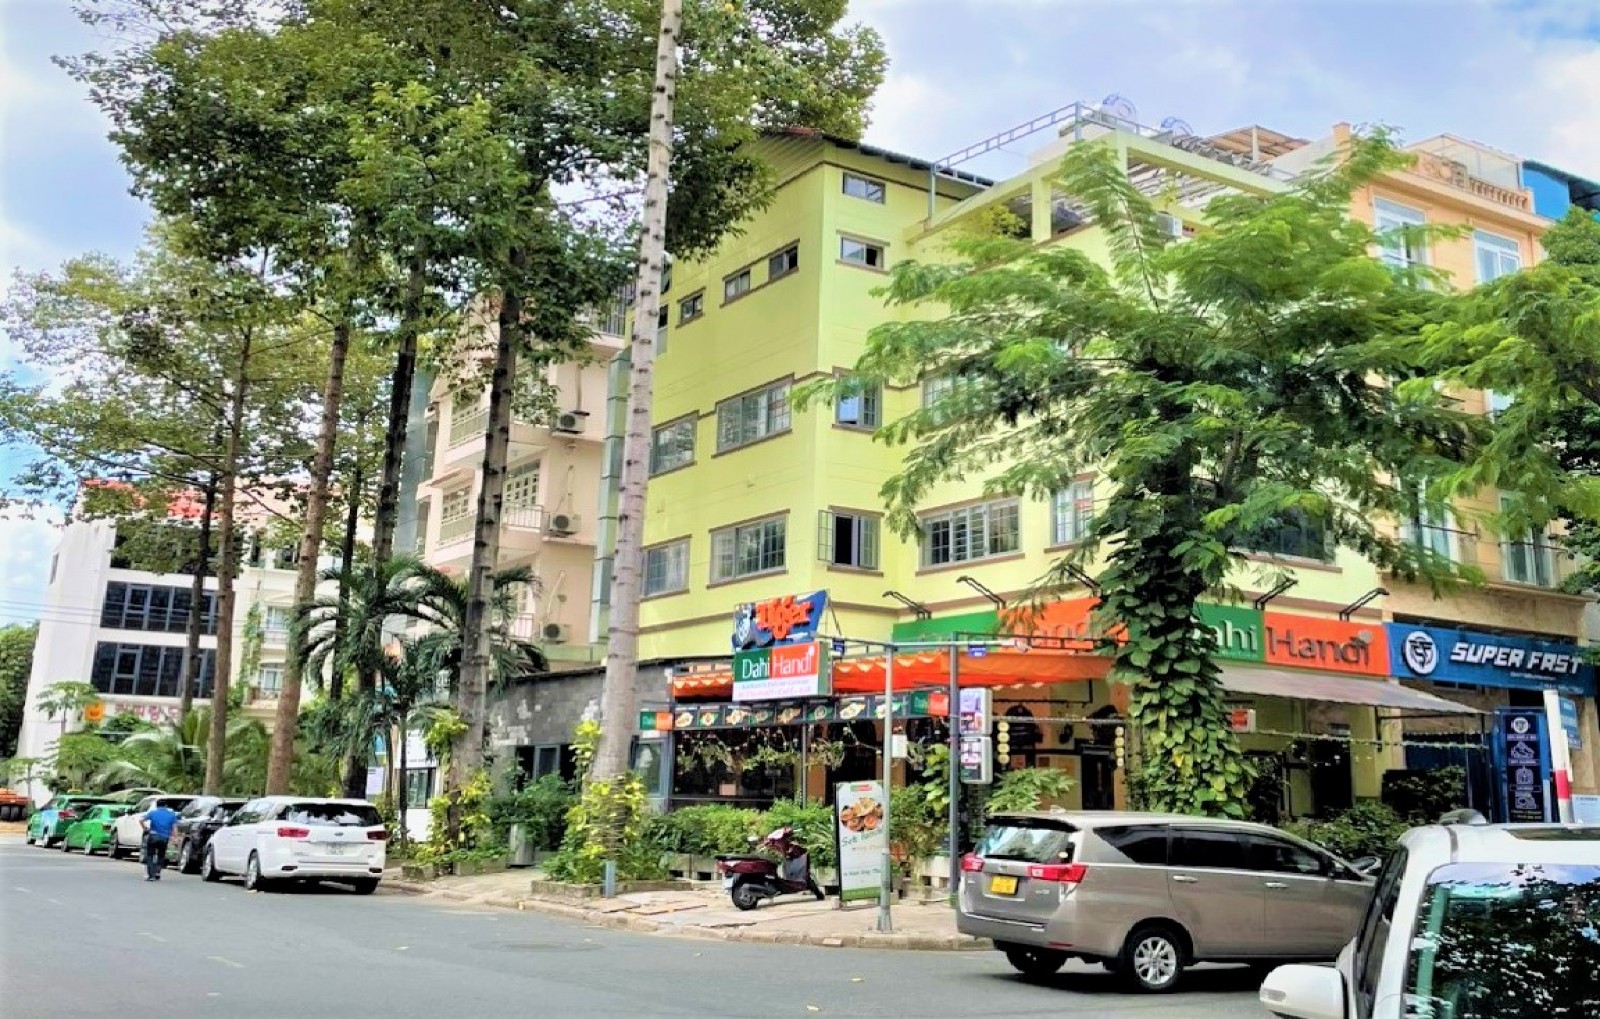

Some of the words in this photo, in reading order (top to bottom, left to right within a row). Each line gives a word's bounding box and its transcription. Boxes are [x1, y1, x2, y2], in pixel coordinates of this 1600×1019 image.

[754, 595, 812, 639] Tiger
[1193, 616, 1258, 652] ahi
[1265, 625, 1373, 666] Handi
[1450, 641, 1526, 669] SUPER
[1526, 651, 1583, 675] FAST
[742, 657, 770, 679] Dahi
[772, 647, 815, 676] Handi
